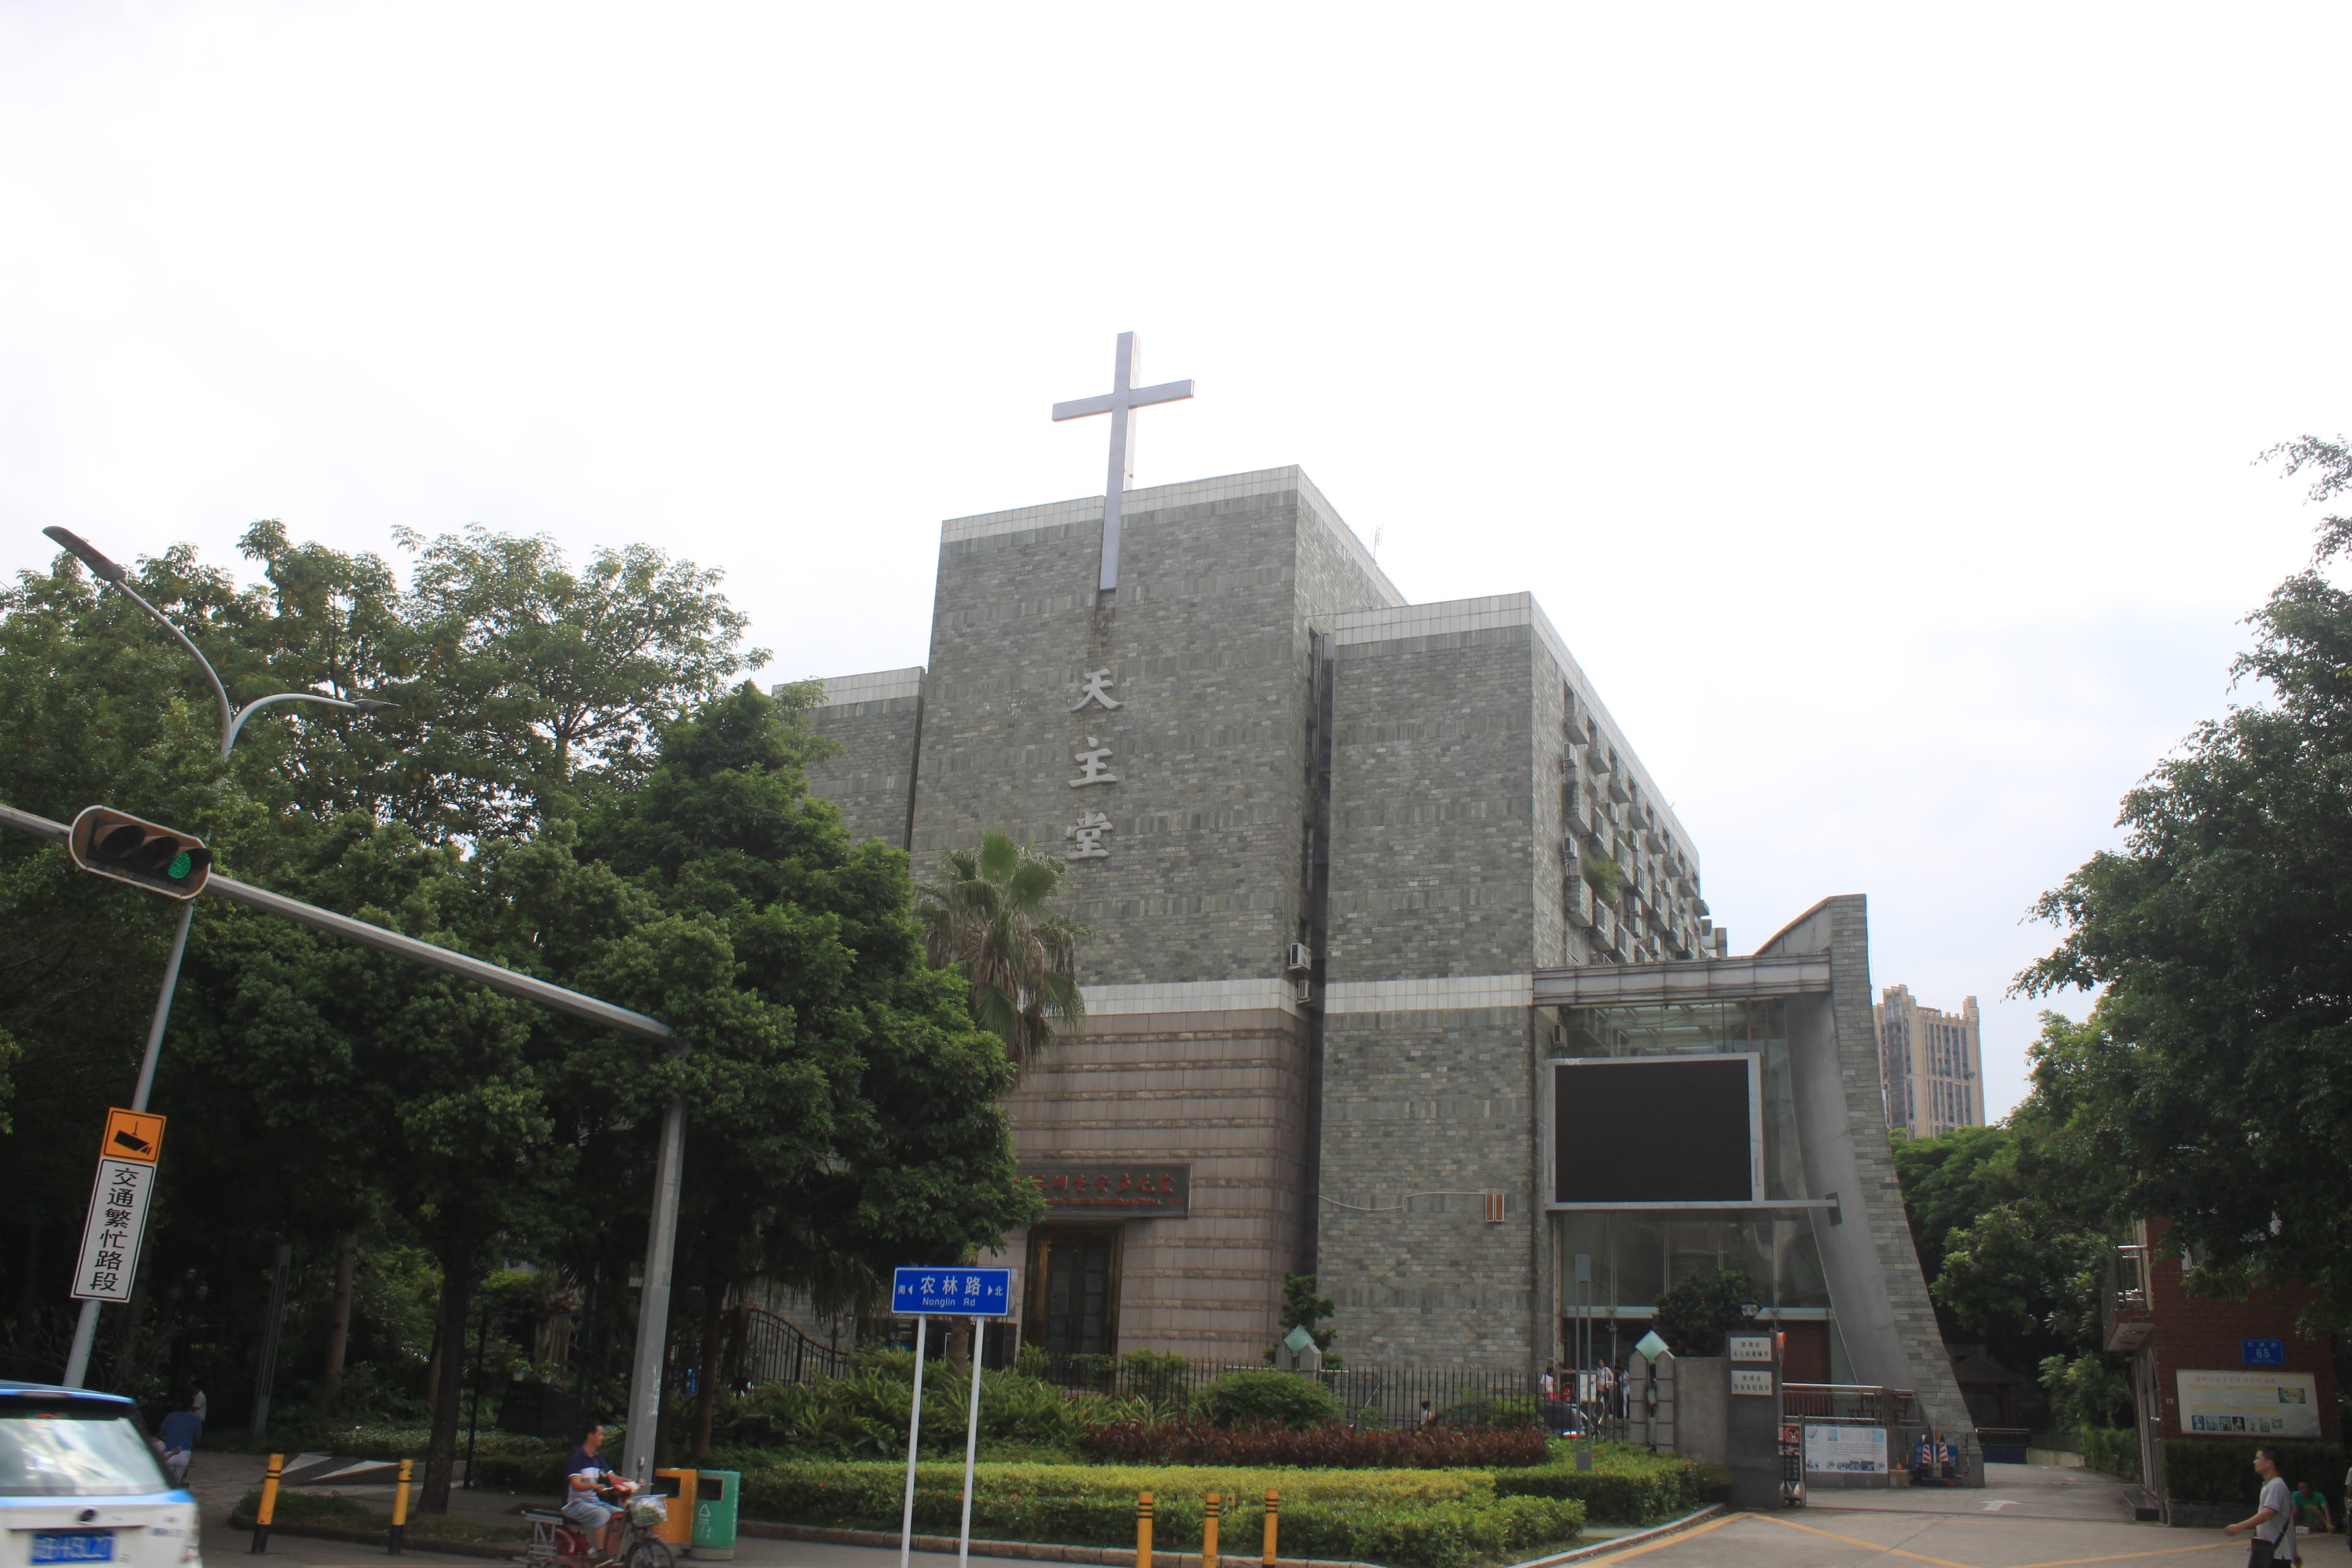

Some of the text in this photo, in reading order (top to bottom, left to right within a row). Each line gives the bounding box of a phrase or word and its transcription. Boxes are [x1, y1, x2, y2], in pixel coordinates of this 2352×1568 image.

[1066, 668, 1121, 859] 天主堂
[90, 1167, 139, 1291] 交通繁忙路段
[920, 1275, 981, 1296] 农林路
[994, 1286, 1003, 1297] 北
[922, 1297, 975, 1308] Nonglin Rd
[2256, 1348, 2270, 1358] 65
